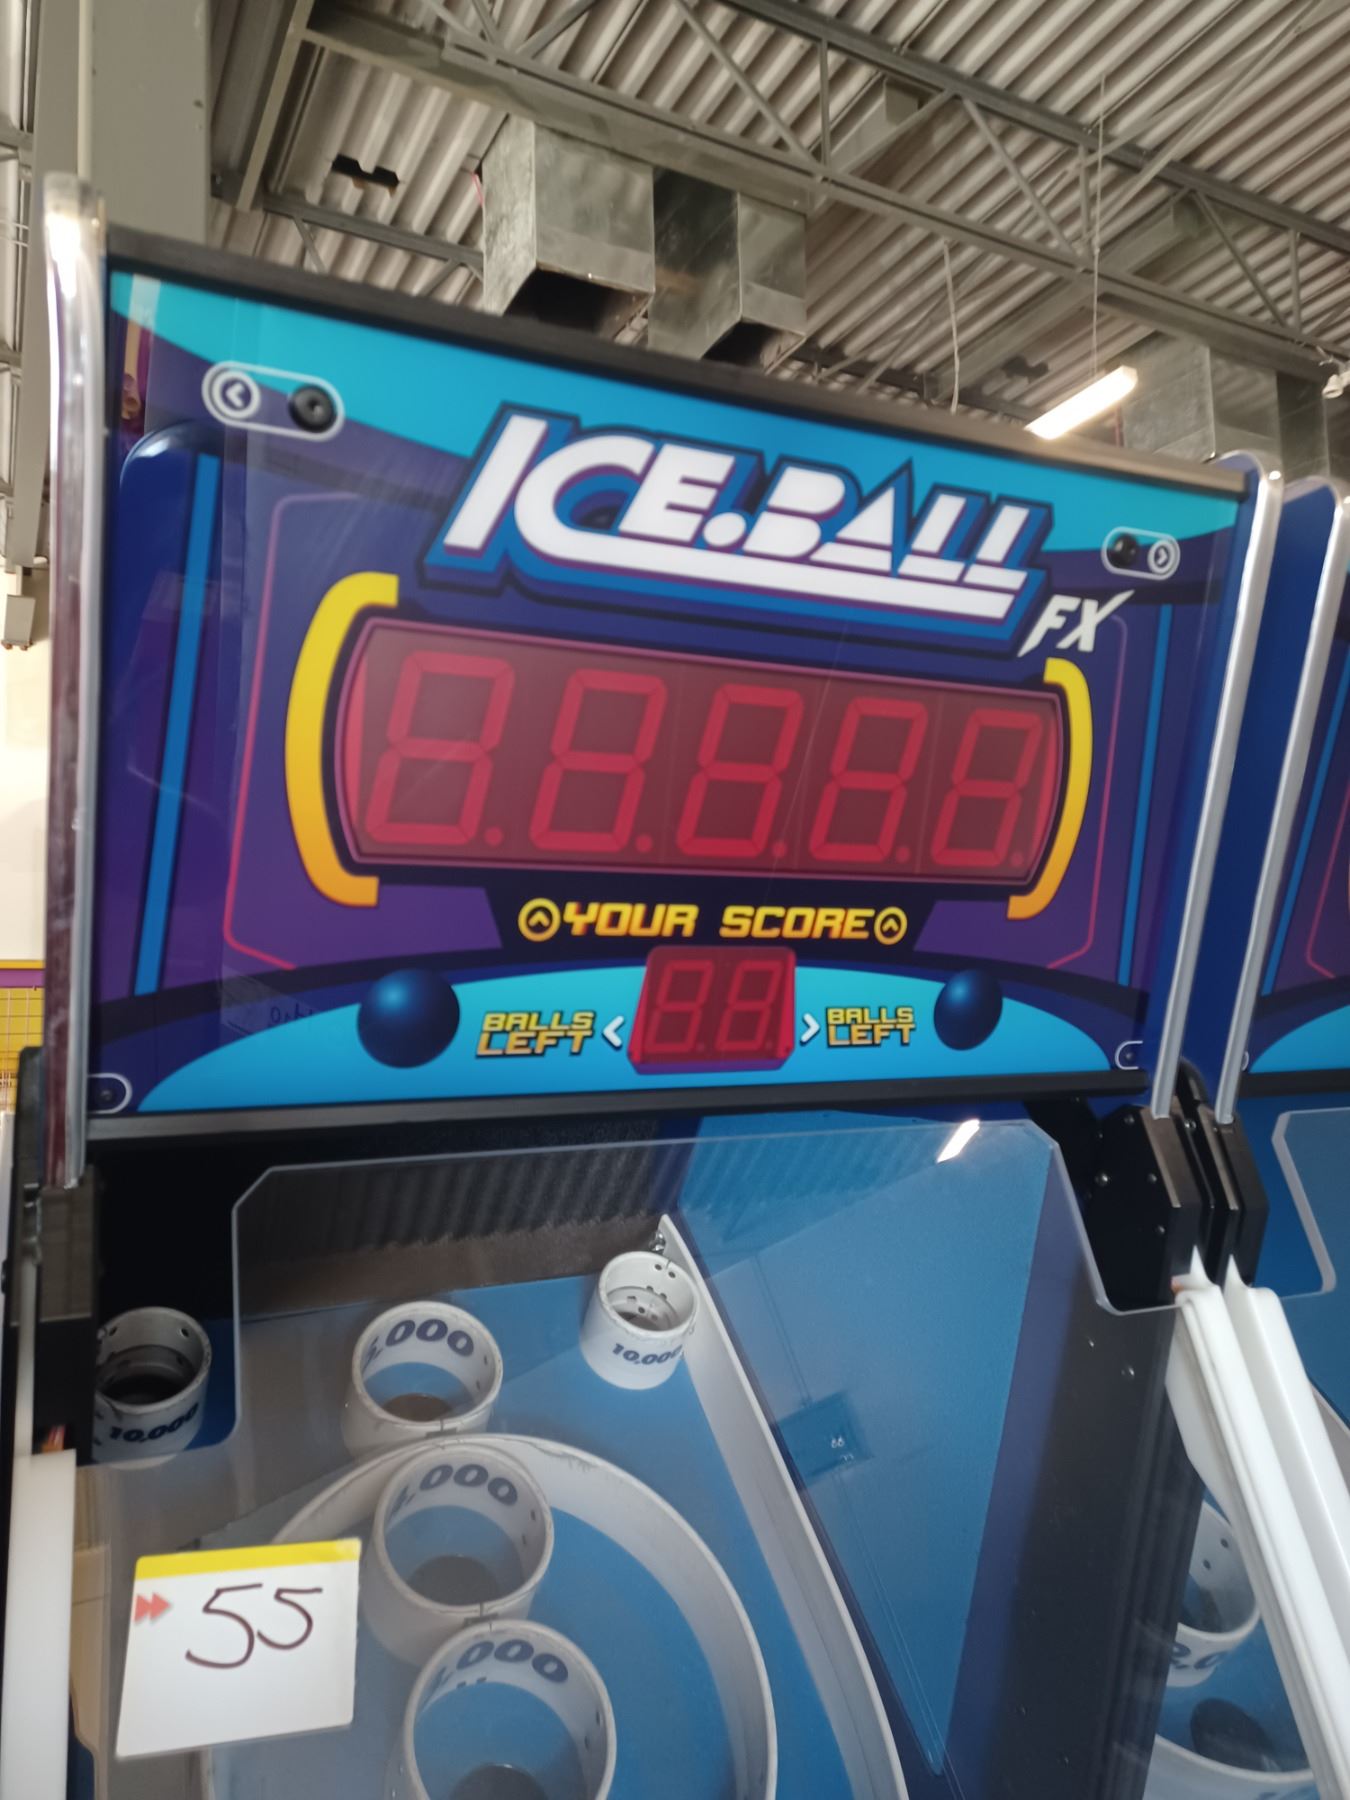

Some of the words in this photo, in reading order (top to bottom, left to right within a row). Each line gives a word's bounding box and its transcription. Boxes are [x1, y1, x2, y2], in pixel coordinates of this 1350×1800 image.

[1017, 588, 1136, 658] FX
[562, 901, 699, 938] YOUR
[718, 904, 876, 940] SCORE
[481, 1010, 598, 1032] BALLS
[826, 1006, 915, 1025] BALLS
[475, 1030, 595, 1057] LEFT
[827, 1023, 917, 1046] LEFT
[184, 1582, 324, 1670] 55
[430, 1638, 569, 1697] ,000
